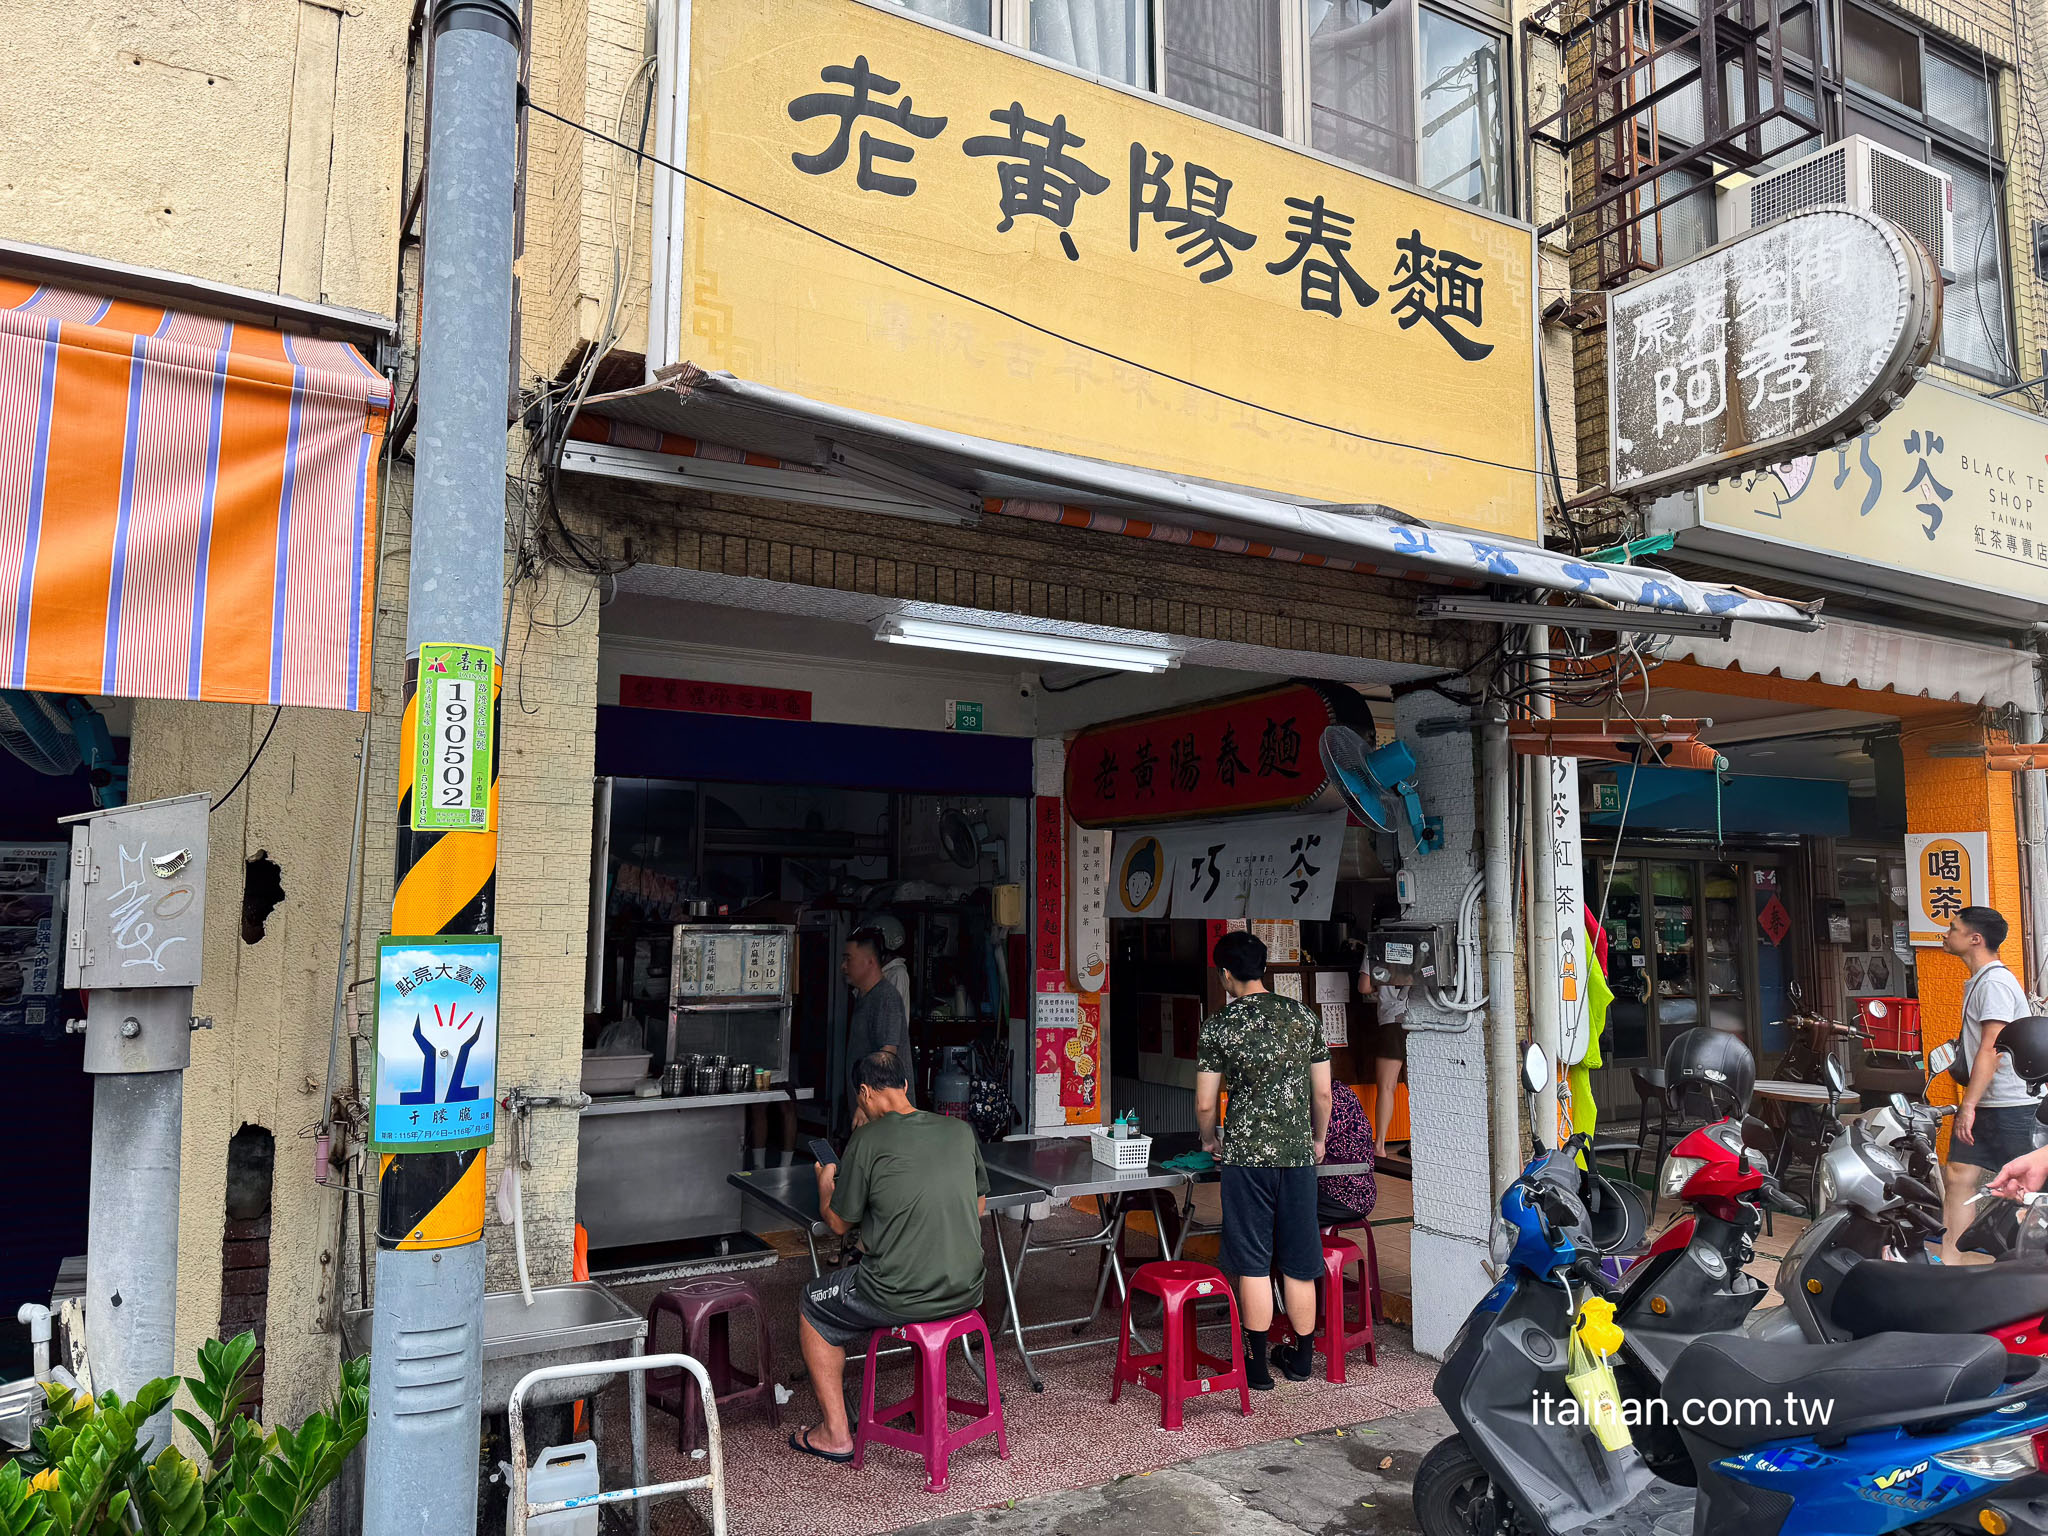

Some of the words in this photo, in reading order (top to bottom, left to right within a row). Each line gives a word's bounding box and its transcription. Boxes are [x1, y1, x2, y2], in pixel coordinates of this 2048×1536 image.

[787, 54, 1495, 360] 老黃陽春麵
[1961, 455, 2015, 486] BLACK
[1989, 488, 2033, 513] SHOP
[1991, 511, 2033, 531] TAIWAN
[1974, 524, 2048, 562] 紅茶專賣店
[457, 671, 488, 681] TAINAN
[962, 715, 977, 727] 38
[441, 683, 467, 807] 190502
[1094, 717, 1301, 800] 老黃陽春麵
[1604, 797, 1615, 806] 34
[27, 850, 58, 858] TOYOTA
[1253, 877, 1279, 887] SHOP
[1258, 867, 1277, 877] TEA
[1928, 849, 1962, 918] 喝茶
[1768, 905, 1785, 936] 春
[33, 919, 52, 993] 最強大的陣容
[394, 962, 488, 998] 點亮大臺南
